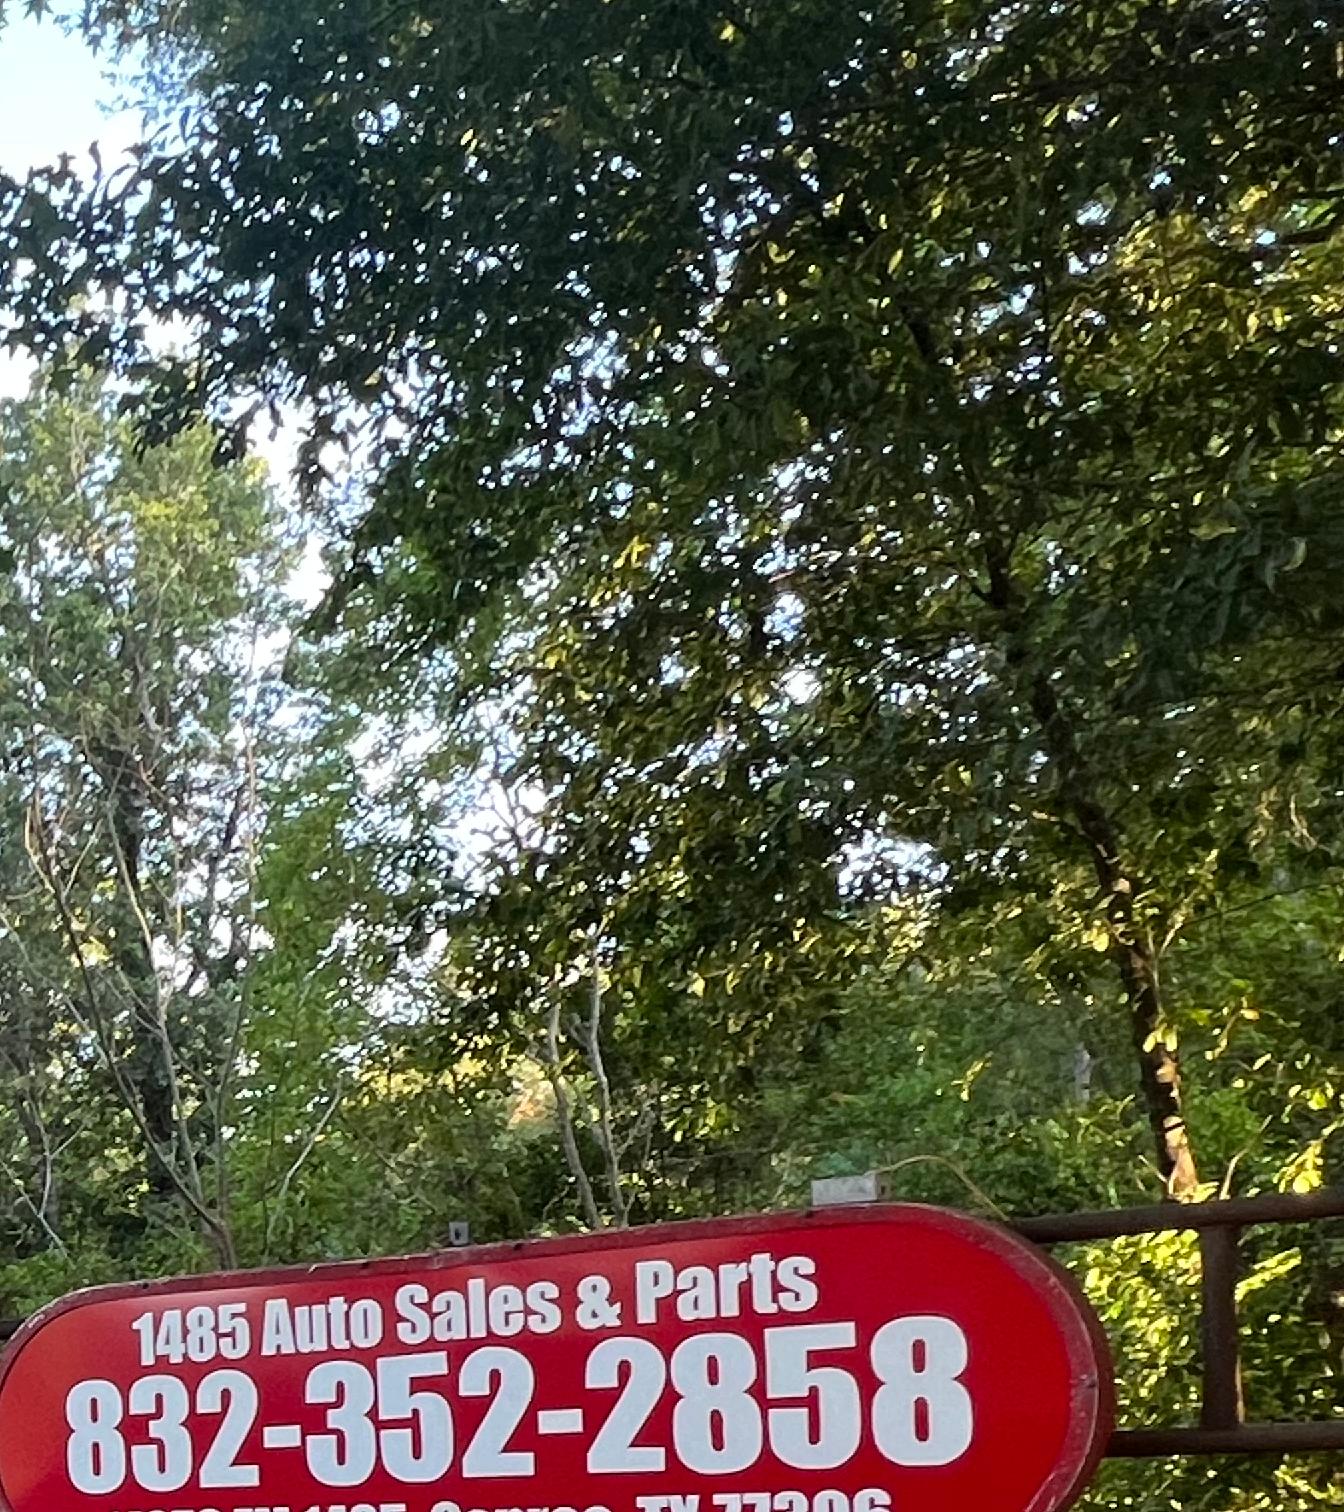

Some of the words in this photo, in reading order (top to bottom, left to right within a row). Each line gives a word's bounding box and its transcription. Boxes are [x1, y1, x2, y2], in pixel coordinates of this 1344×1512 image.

[131, 1301, 251, 1366] 1485
[260, 1295, 383, 1357] Auto
[393, 1276, 562, 1345] Sales
[574, 1273, 623, 1331] &
[634, 1251, 818, 1325] Parts
[64, 1314, 974, 1496] 832-352-2858
